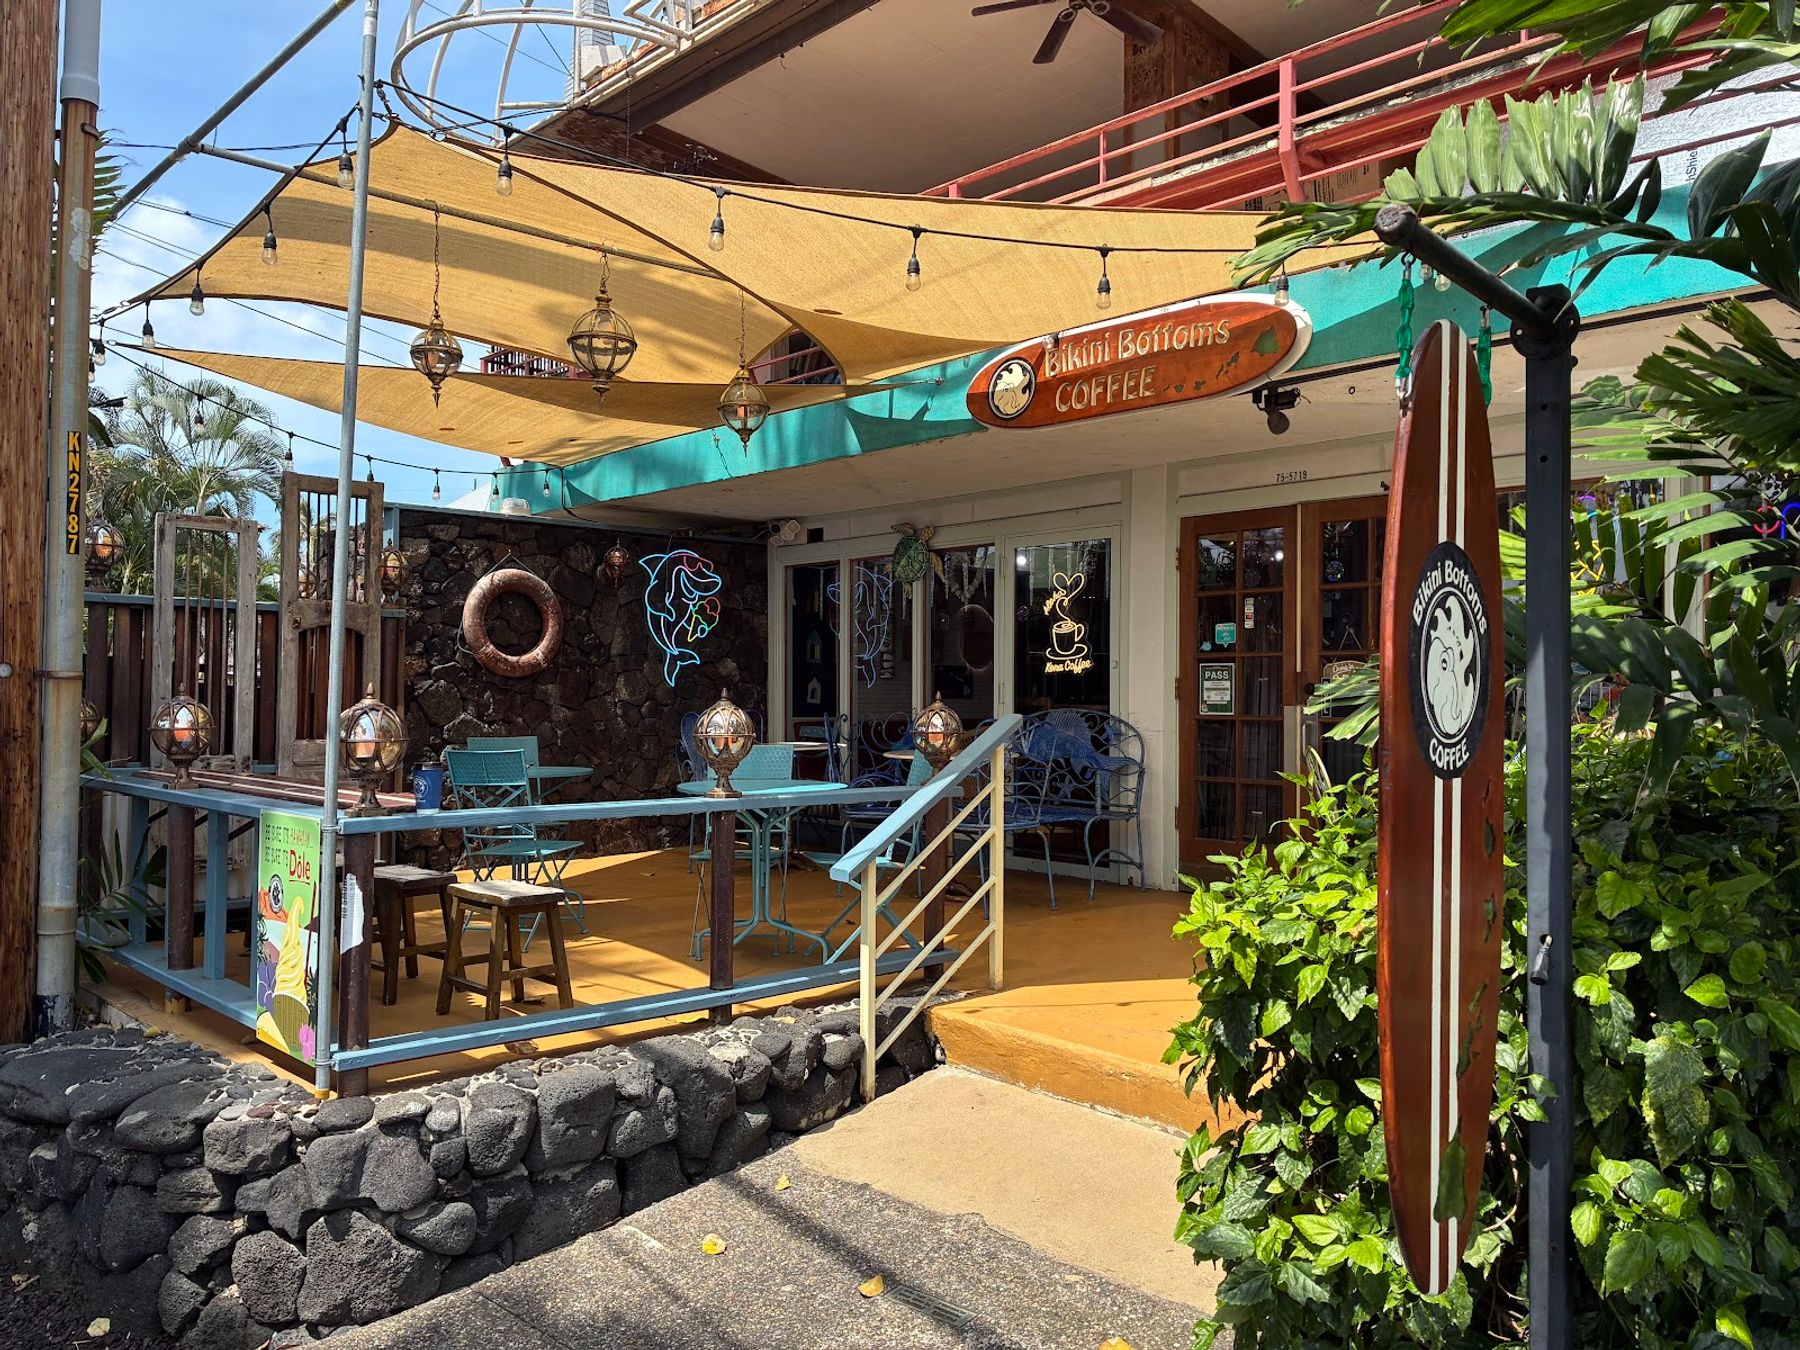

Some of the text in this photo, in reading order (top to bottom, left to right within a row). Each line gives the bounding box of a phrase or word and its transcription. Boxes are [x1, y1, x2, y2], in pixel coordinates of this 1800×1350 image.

[1044, 319, 1231, 378] Bikini Bottoms
[1055, 365, 1157, 412] COFFEE
[68, 431, 80, 554] KN2787
[1275, 470, 1308, 483] 75-5719
[1412, 560, 1488, 635] Bikini Bottoms
[1064, 658, 1093, 674] Coffee
[1204, 670, 1229, 680] PASS
[1429, 736, 1470, 771] COFFEE
[289, 849, 311, 880] Dole
